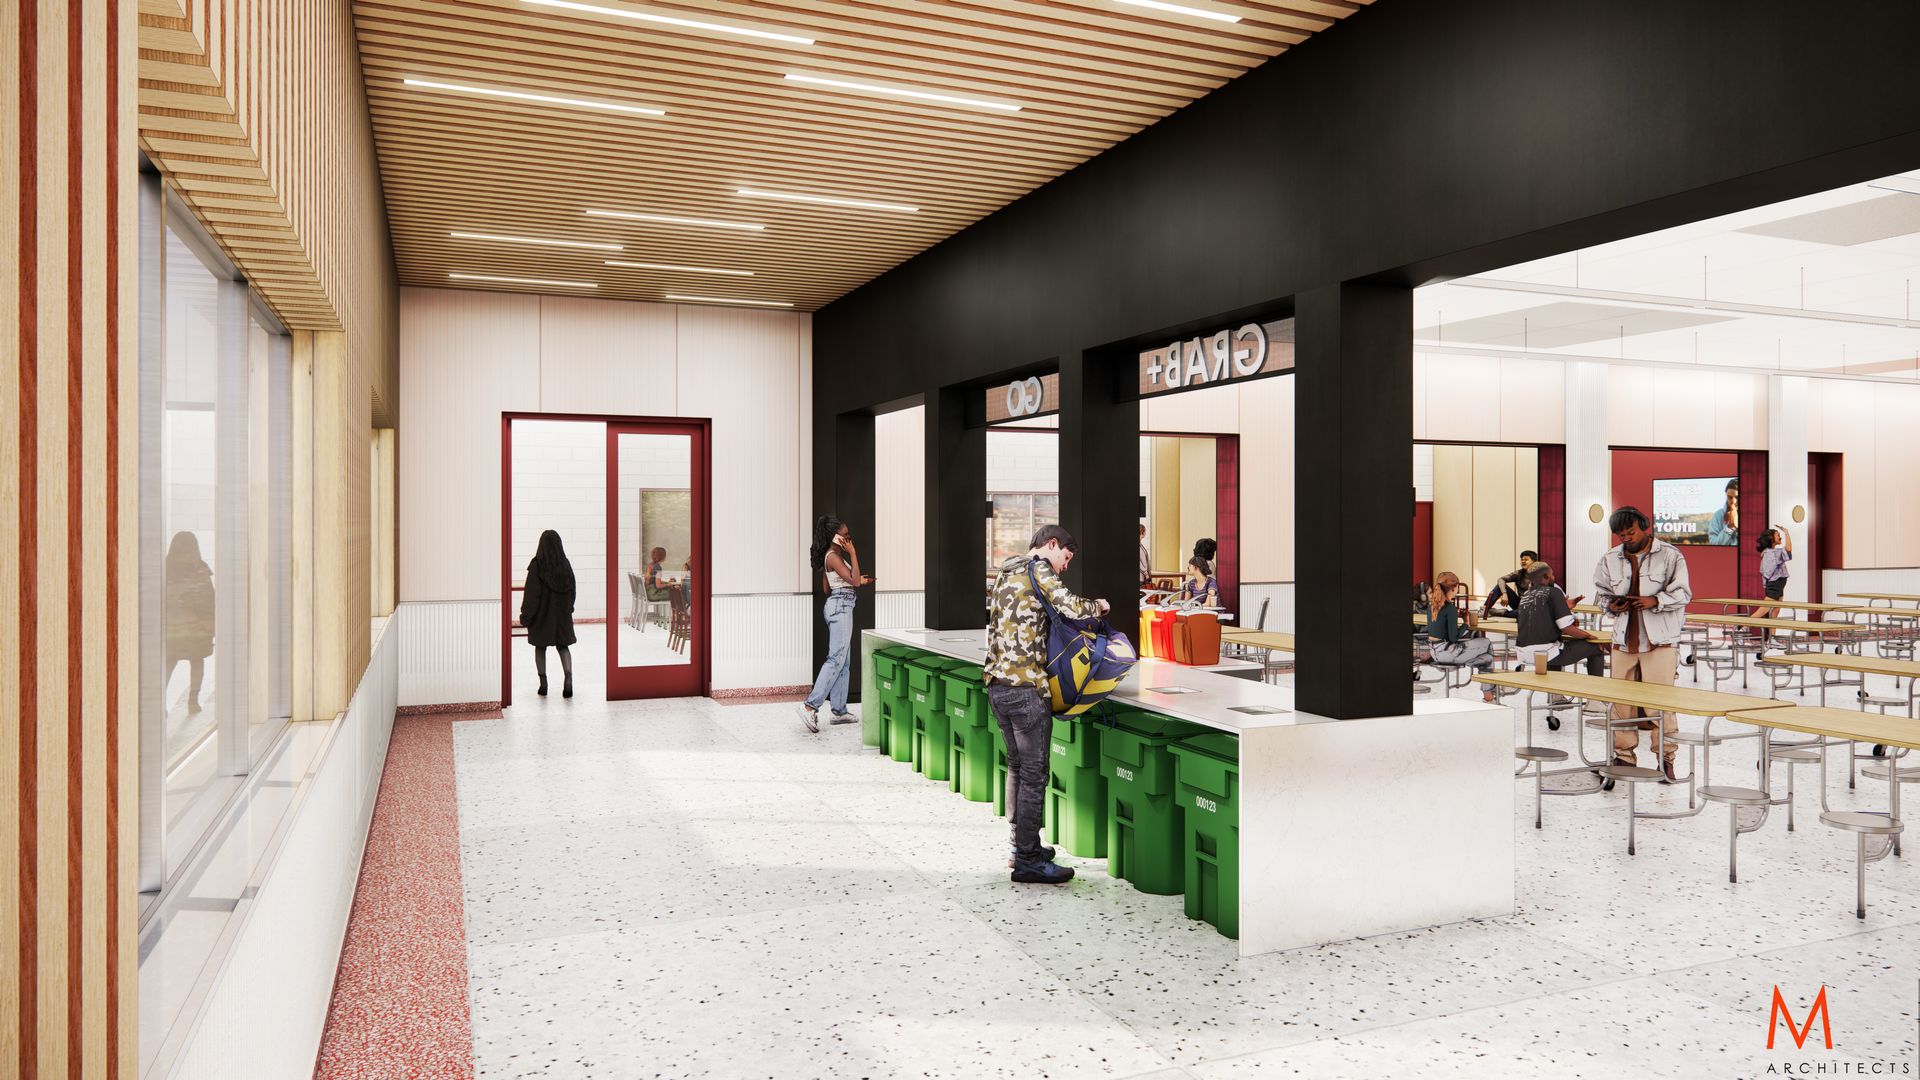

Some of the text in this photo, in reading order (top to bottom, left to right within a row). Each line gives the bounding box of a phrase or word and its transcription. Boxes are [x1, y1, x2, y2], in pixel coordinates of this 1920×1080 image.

[1655, 522, 1697, 533] YOUTH
[1116, 766, 1134, 782] 000123
[1195, 795, 1217, 813] 000123
